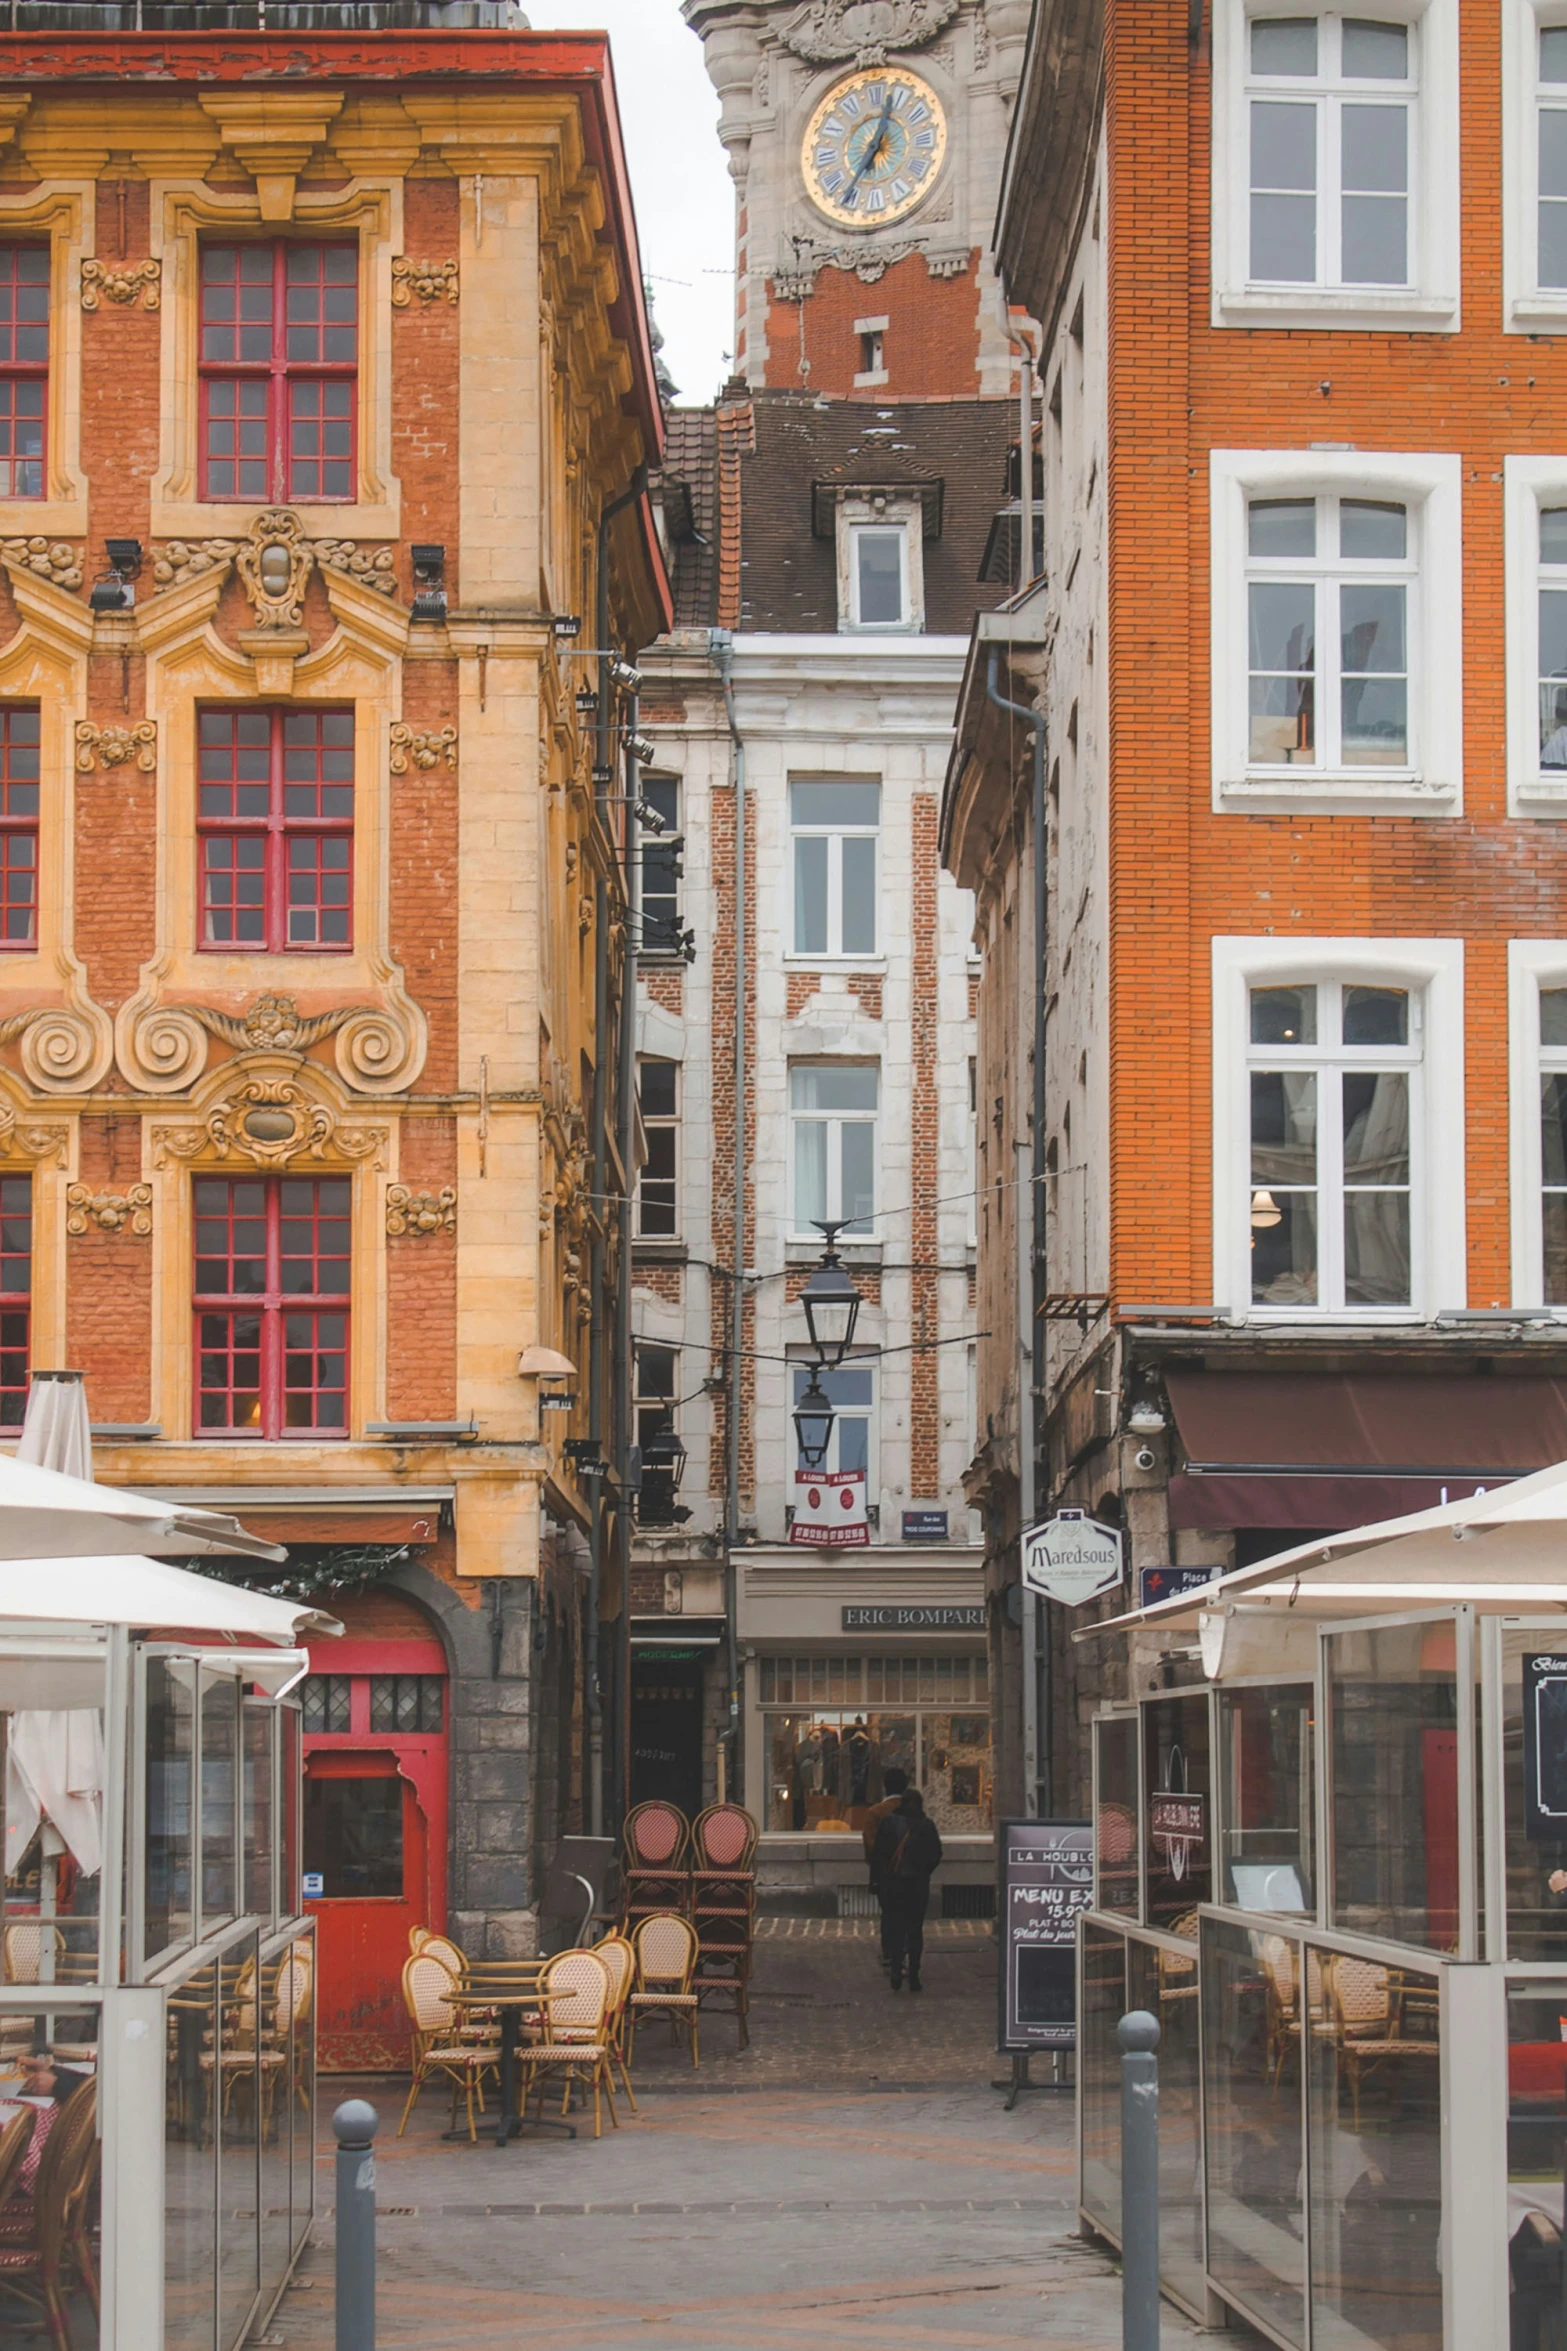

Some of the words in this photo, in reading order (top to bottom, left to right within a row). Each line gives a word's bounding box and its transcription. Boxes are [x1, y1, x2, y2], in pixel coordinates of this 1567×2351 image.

[1031, 1544, 1115, 1567] Maredsous
[1182, 1571, 1207, 1583] Place
[846, 1609, 892, 1624] ERIC
[1017, 1851, 1034, 1861] LA
[1014, 1888, 1064, 1904] MENU
[1029, 1919, 1052, 1928] PLAT
[1013, 1927, 1039, 1940] Plat
[1040, 1928, 1054, 1939] du
